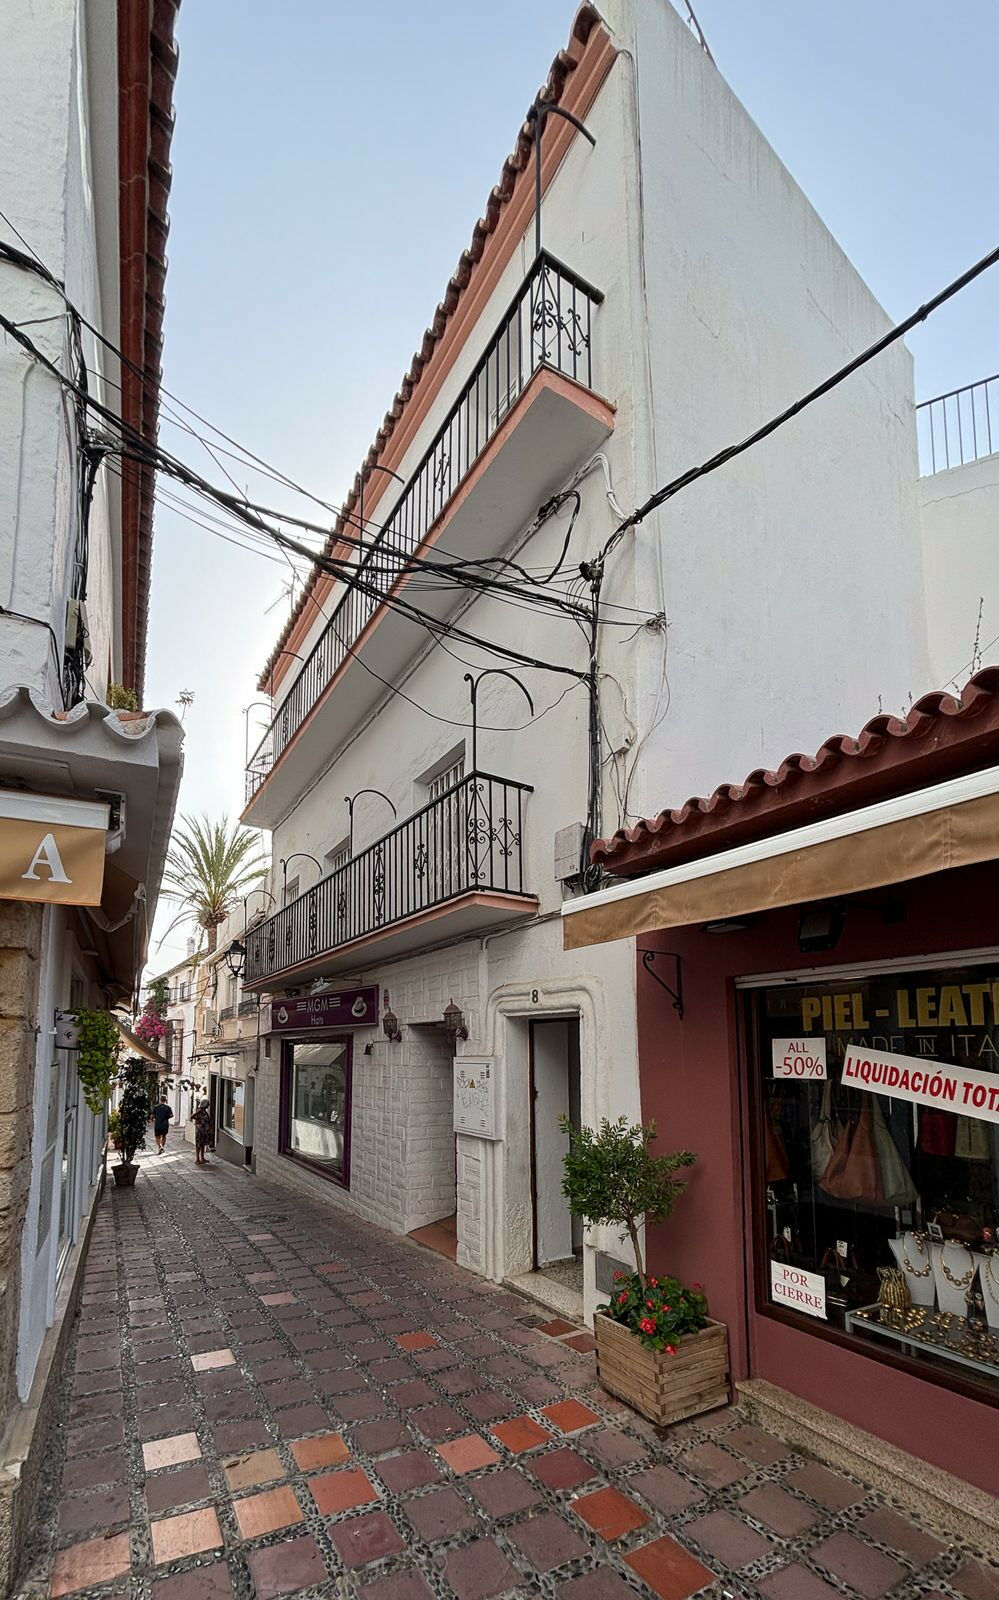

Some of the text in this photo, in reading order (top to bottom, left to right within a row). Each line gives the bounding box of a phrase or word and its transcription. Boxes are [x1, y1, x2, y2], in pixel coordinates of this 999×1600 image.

[21, 833, 72, 884] A
[306, 997, 329, 1013] MGM
[531, 989, 539, 1004] 8
[310, 1015, 324, 1025] Hats
[800, 992, 870, 1031] PIEL
[875, 1009, 889, 1017] -
[787, 1042, 809, 1053] ALL
[917, 1036, 937, 1055] IN
[775, 1056, 824, 1077] -50%
[845, 1057, 999, 1112] LIQUIDACIÓN TOT
[783, 1269, 809, 1288] POR
[774, 1282, 823, 1310] CIERRE
